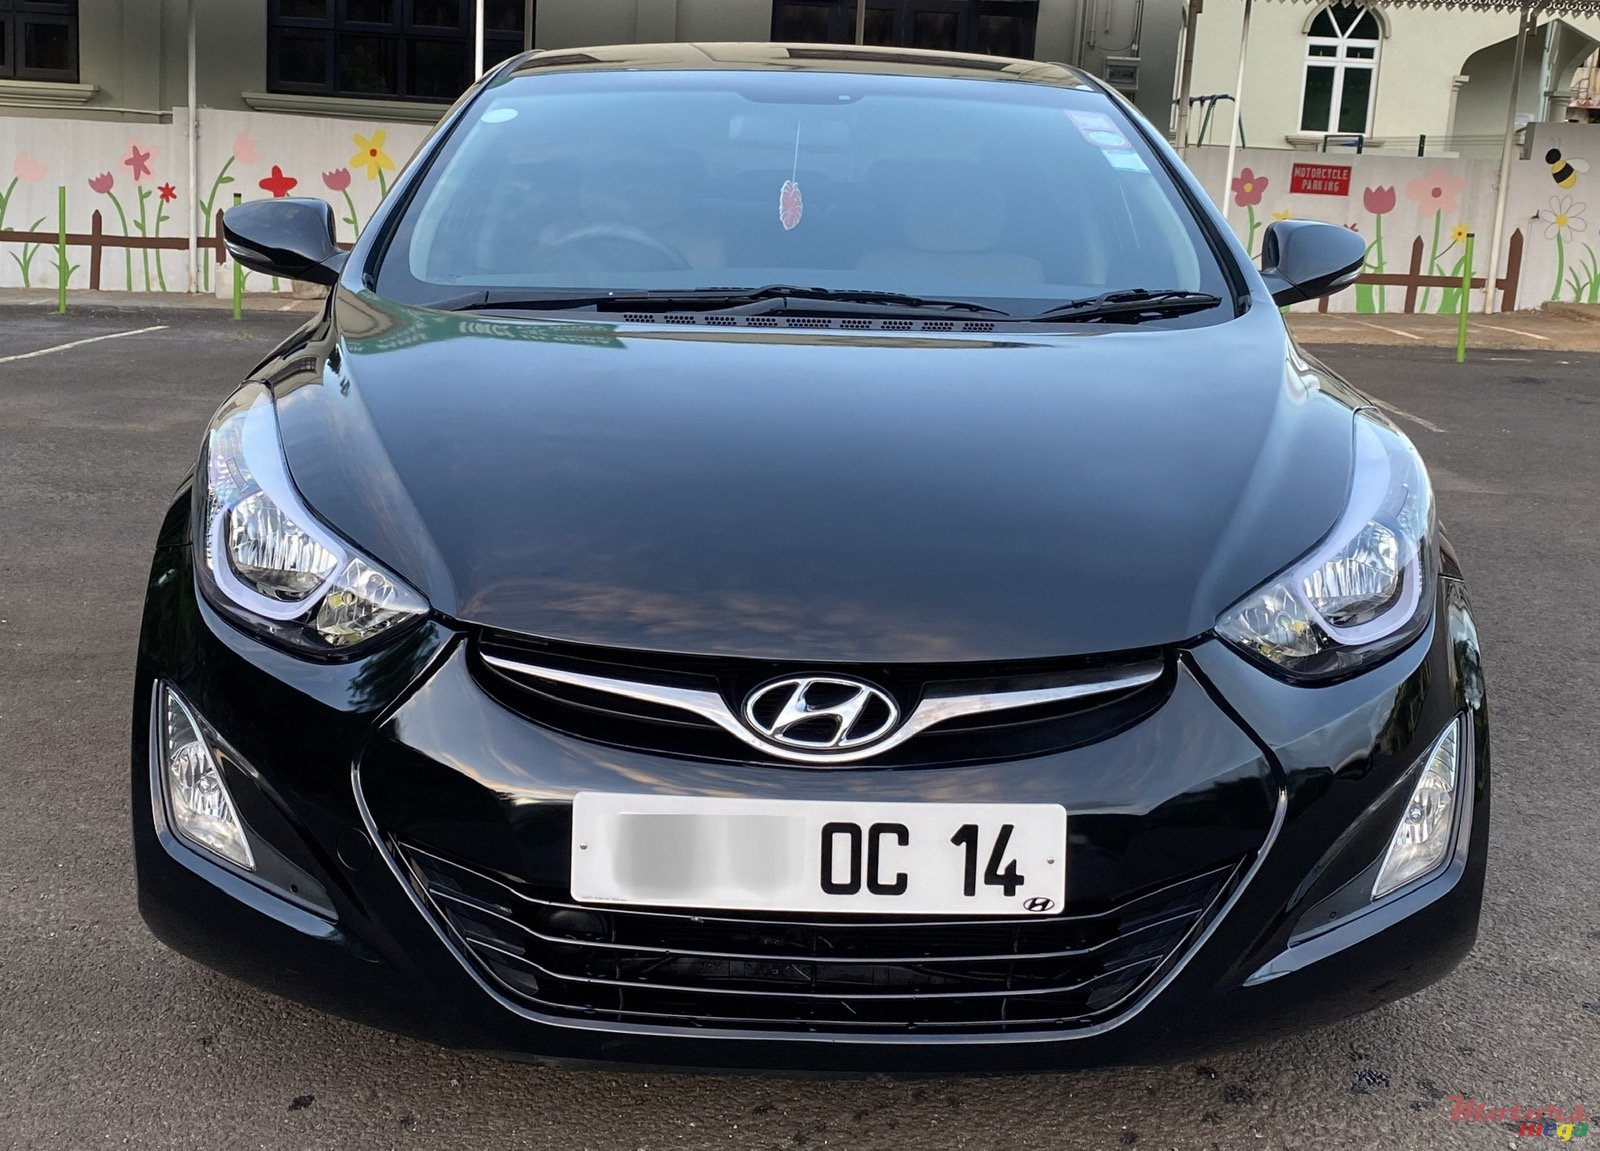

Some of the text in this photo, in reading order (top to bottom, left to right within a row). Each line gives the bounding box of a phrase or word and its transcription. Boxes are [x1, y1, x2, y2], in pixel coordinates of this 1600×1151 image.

[1294, 167, 1349, 180] MOTORCYCLE
[1302, 179, 1340, 192] PARKING
[820, 822, 1025, 897] OC 14
